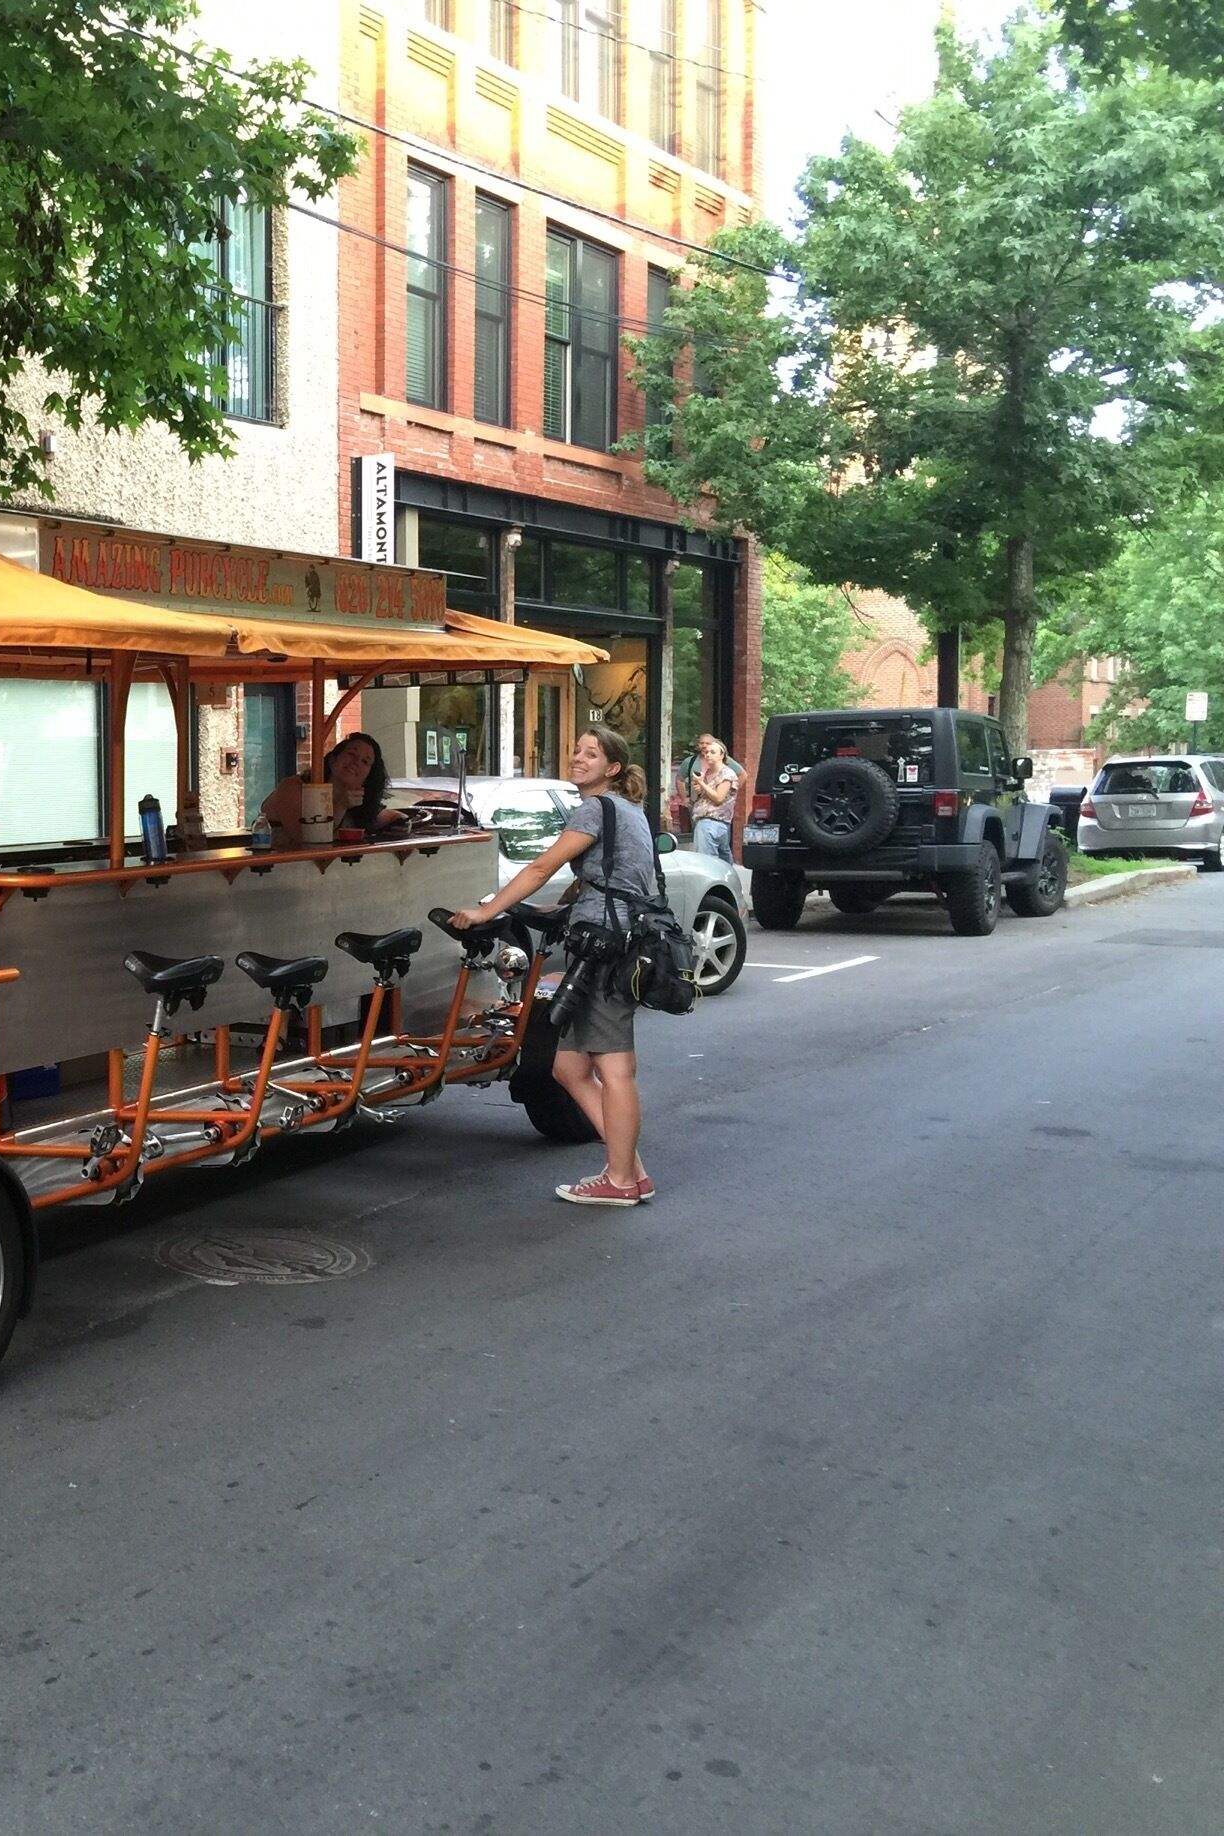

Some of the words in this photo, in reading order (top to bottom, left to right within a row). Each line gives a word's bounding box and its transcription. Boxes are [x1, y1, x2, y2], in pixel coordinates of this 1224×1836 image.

[376, 461, 387, 563] ALTAMONT
[52, 536, 162, 593] AMAZING
[376, 574, 405, 619] 214
[591, 710, 601, 721] 18
